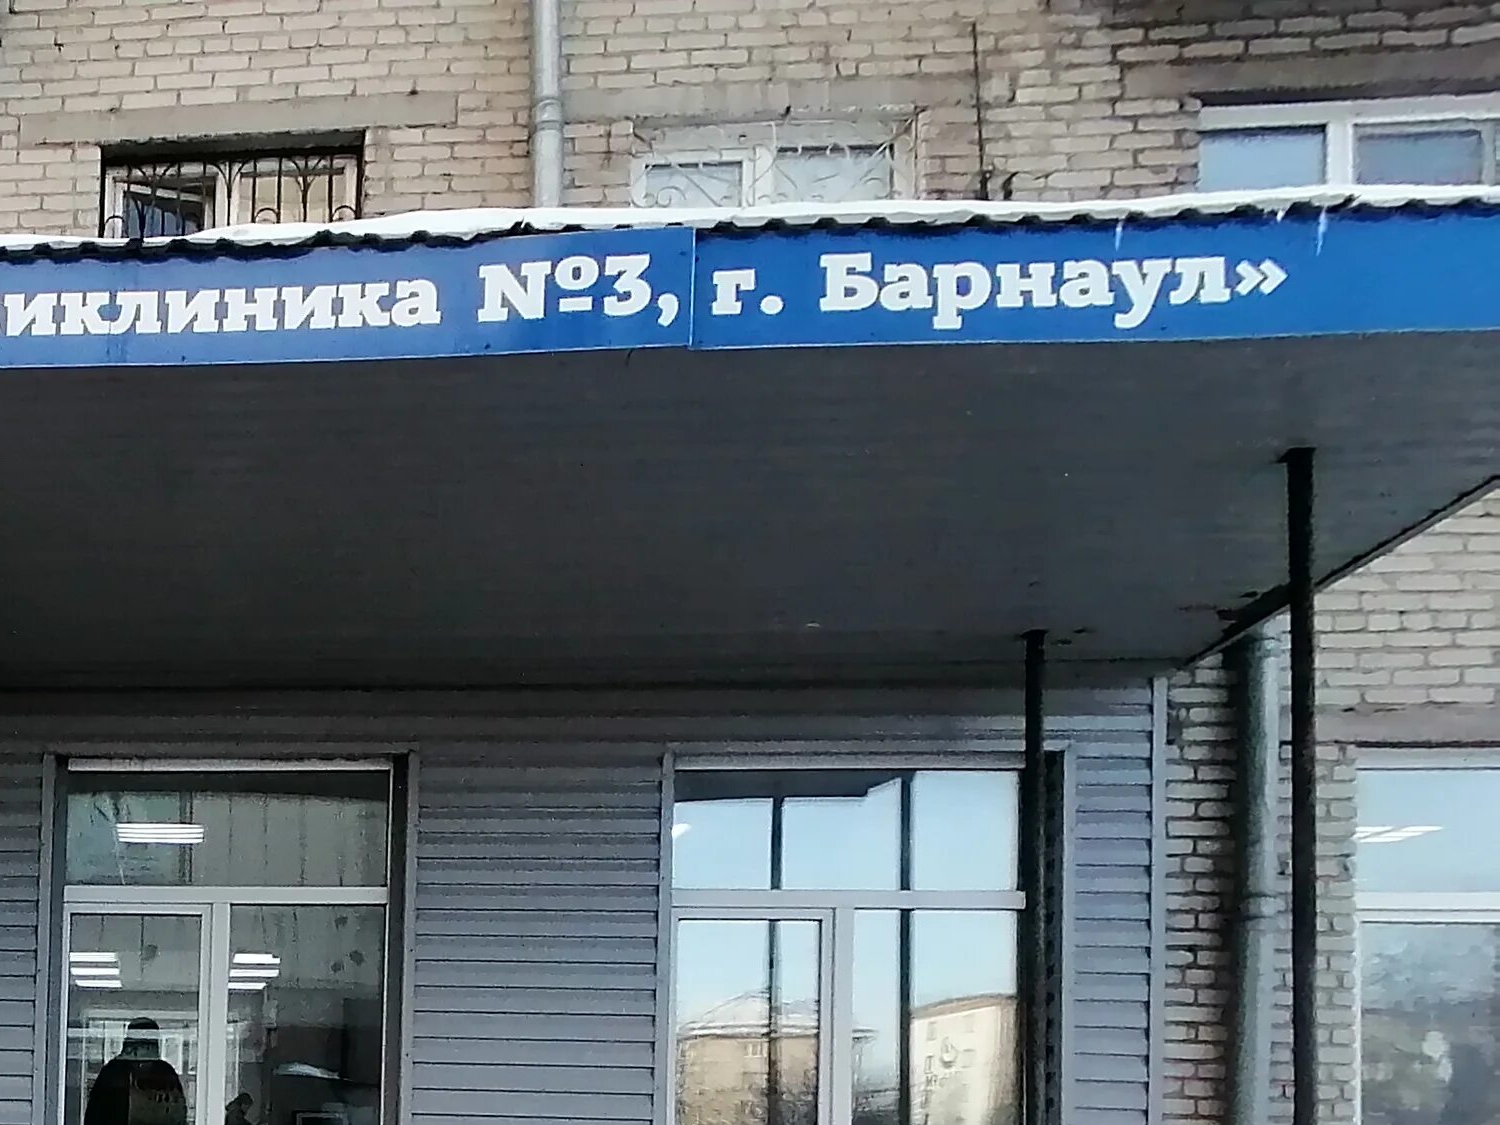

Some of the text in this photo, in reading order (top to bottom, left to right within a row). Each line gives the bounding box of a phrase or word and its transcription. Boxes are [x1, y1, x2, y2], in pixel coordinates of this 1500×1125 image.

[477, 255, 680, 327] №3,
[711, 268, 785, 315] г.
[819, 252, 1288, 329] Барнаул»
